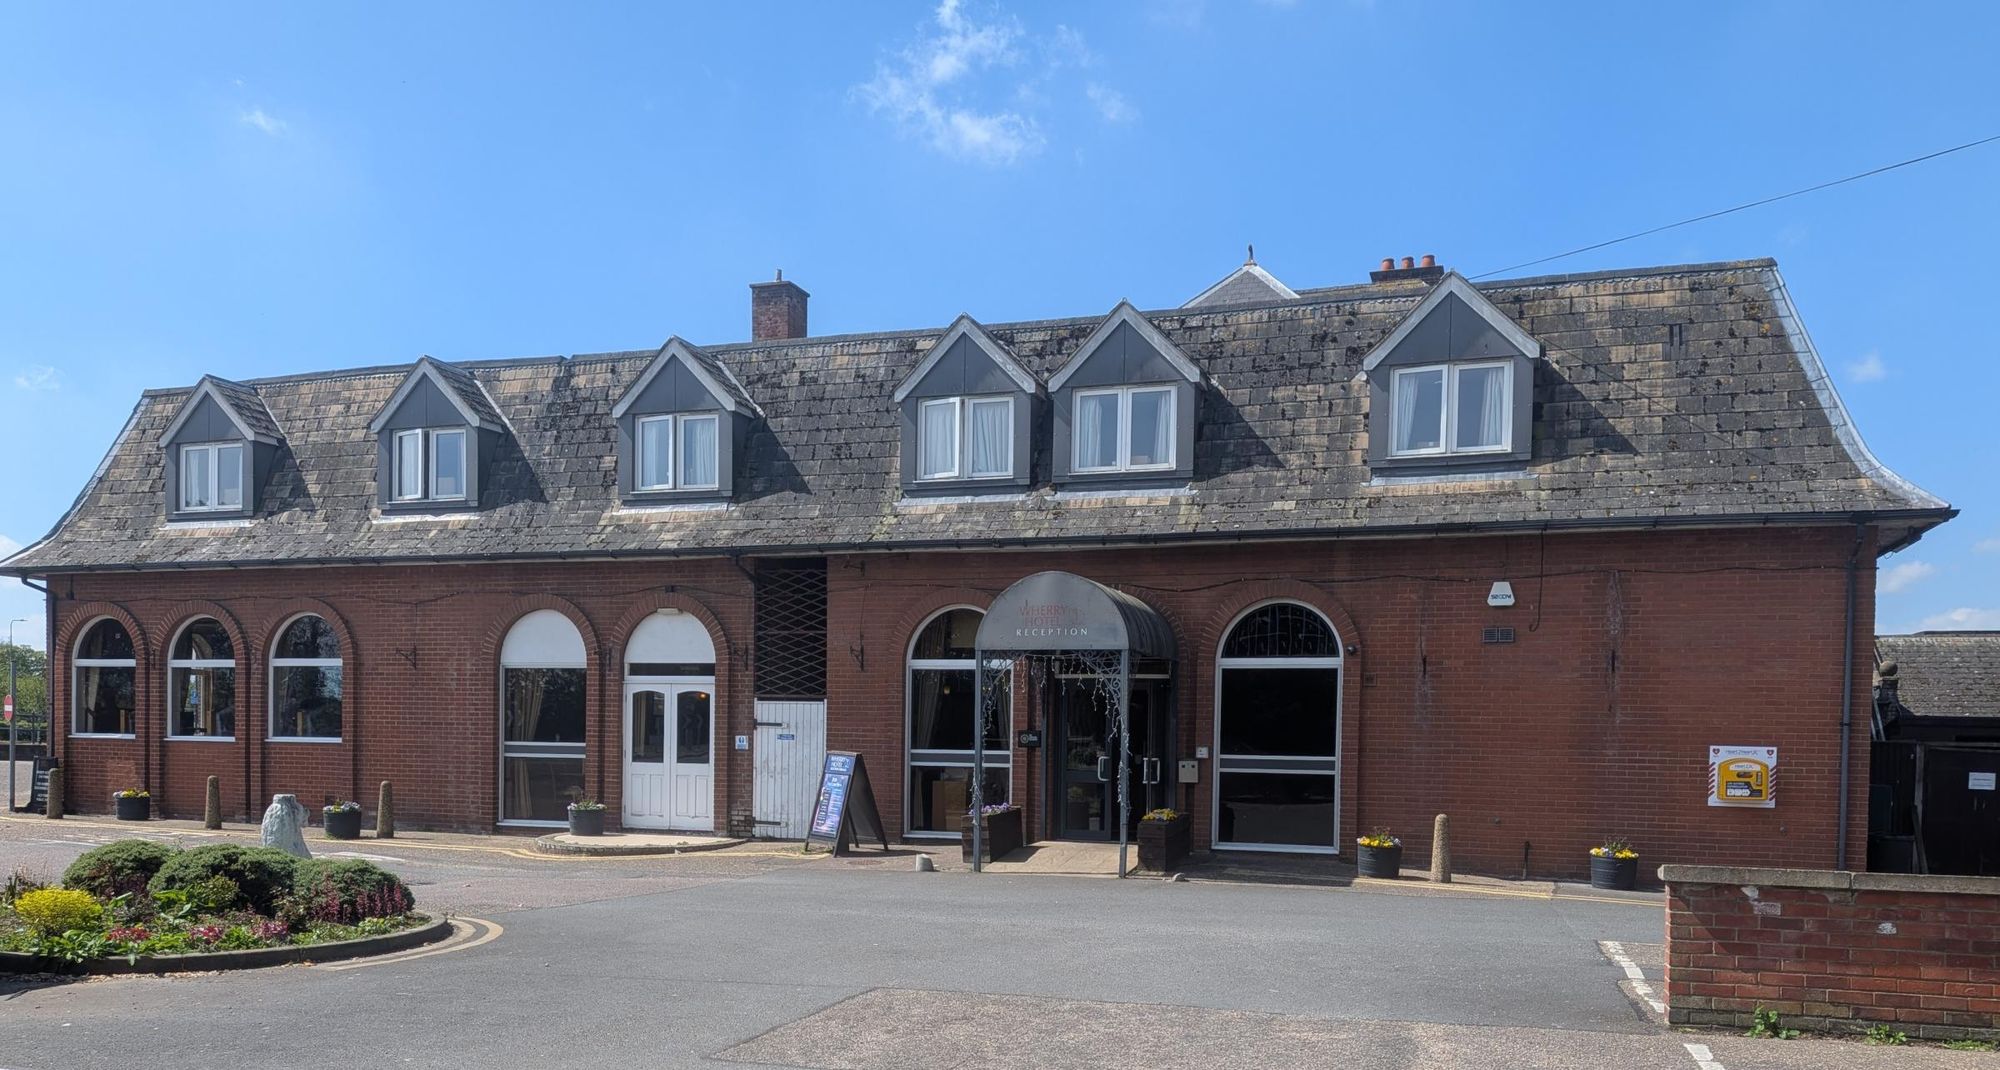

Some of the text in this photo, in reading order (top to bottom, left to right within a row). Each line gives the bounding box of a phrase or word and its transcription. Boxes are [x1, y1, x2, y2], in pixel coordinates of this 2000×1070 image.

[1018, 602, 1067, 616] WHERRY
[1024, 616, 1061, 627] HOTEL
[1016, 628, 1088, 637] RECEPTION
